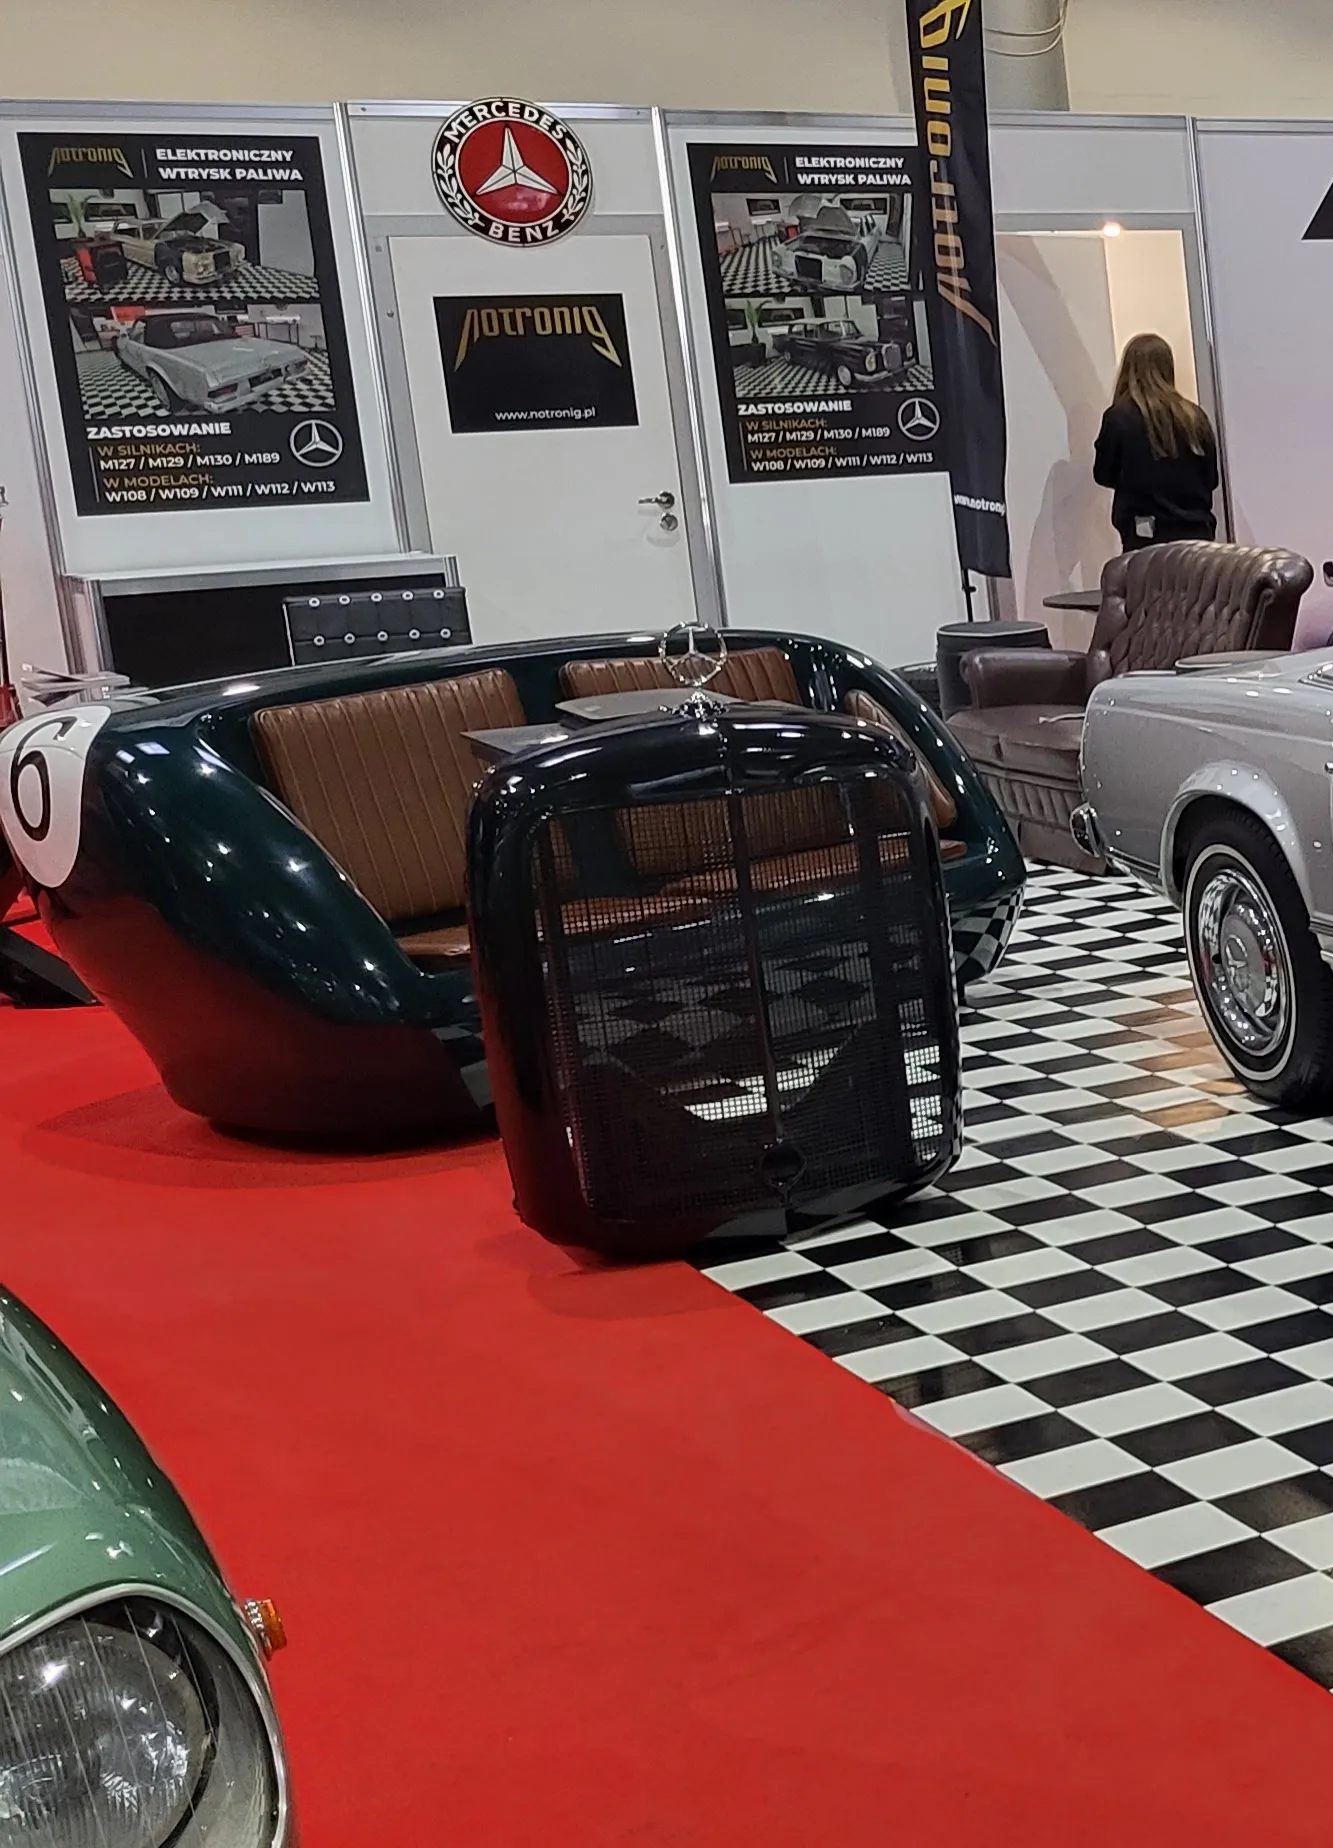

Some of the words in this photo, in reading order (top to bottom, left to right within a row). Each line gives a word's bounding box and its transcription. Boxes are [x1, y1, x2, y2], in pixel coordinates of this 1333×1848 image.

[444, 101, 567, 144] MERCEDES
[156, 149, 293, 161] ELEKTRONICZNY
[795, 157, 904, 168] ELEKTRONICZNY
[158, 168, 232, 180] WTRYSK
[235, 168, 303, 181] PALIWA
[797, 174, 856, 185] WTRYSK
[858, 174, 912, 185] PALIWA
[488, 221, 559, 243] BENZ
[495, 406, 596, 420] www.notronig.pl
[738, 400, 852, 416] ZASTOSOWANIE
[87, 422, 232, 440] ZASTOSOWANIE
[748, 432, 776, 443] M127
[786, 430, 814, 442] M129
[824, 428, 853, 440] M130
[97, 446, 113, 457] W
[117, 443, 201, 456] SILNIKACH:
[100, 458, 136, 471] M127
[149, 456, 184, 469] M129
[197, 454, 232, 466] M130
[245, 453, 280, 465] M189
[751, 461, 784, 472] W108
[794, 458, 825, 470] W109
[835, 457, 860, 468] W111
[869, 455, 897, 466] W112
[906, 452, 933, 464] W113
[103, 477, 120, 489] W
[124, 473, 214, 487] MODELACH:
[106, 490, 147, 502] W108
[158, 488, 199, 500] W109
[211, 486, 243, 498] W111
[255, 483, 290, 496] W112
[301, 481, 335, 493] W113
[10, 716, 77, 841] 6
